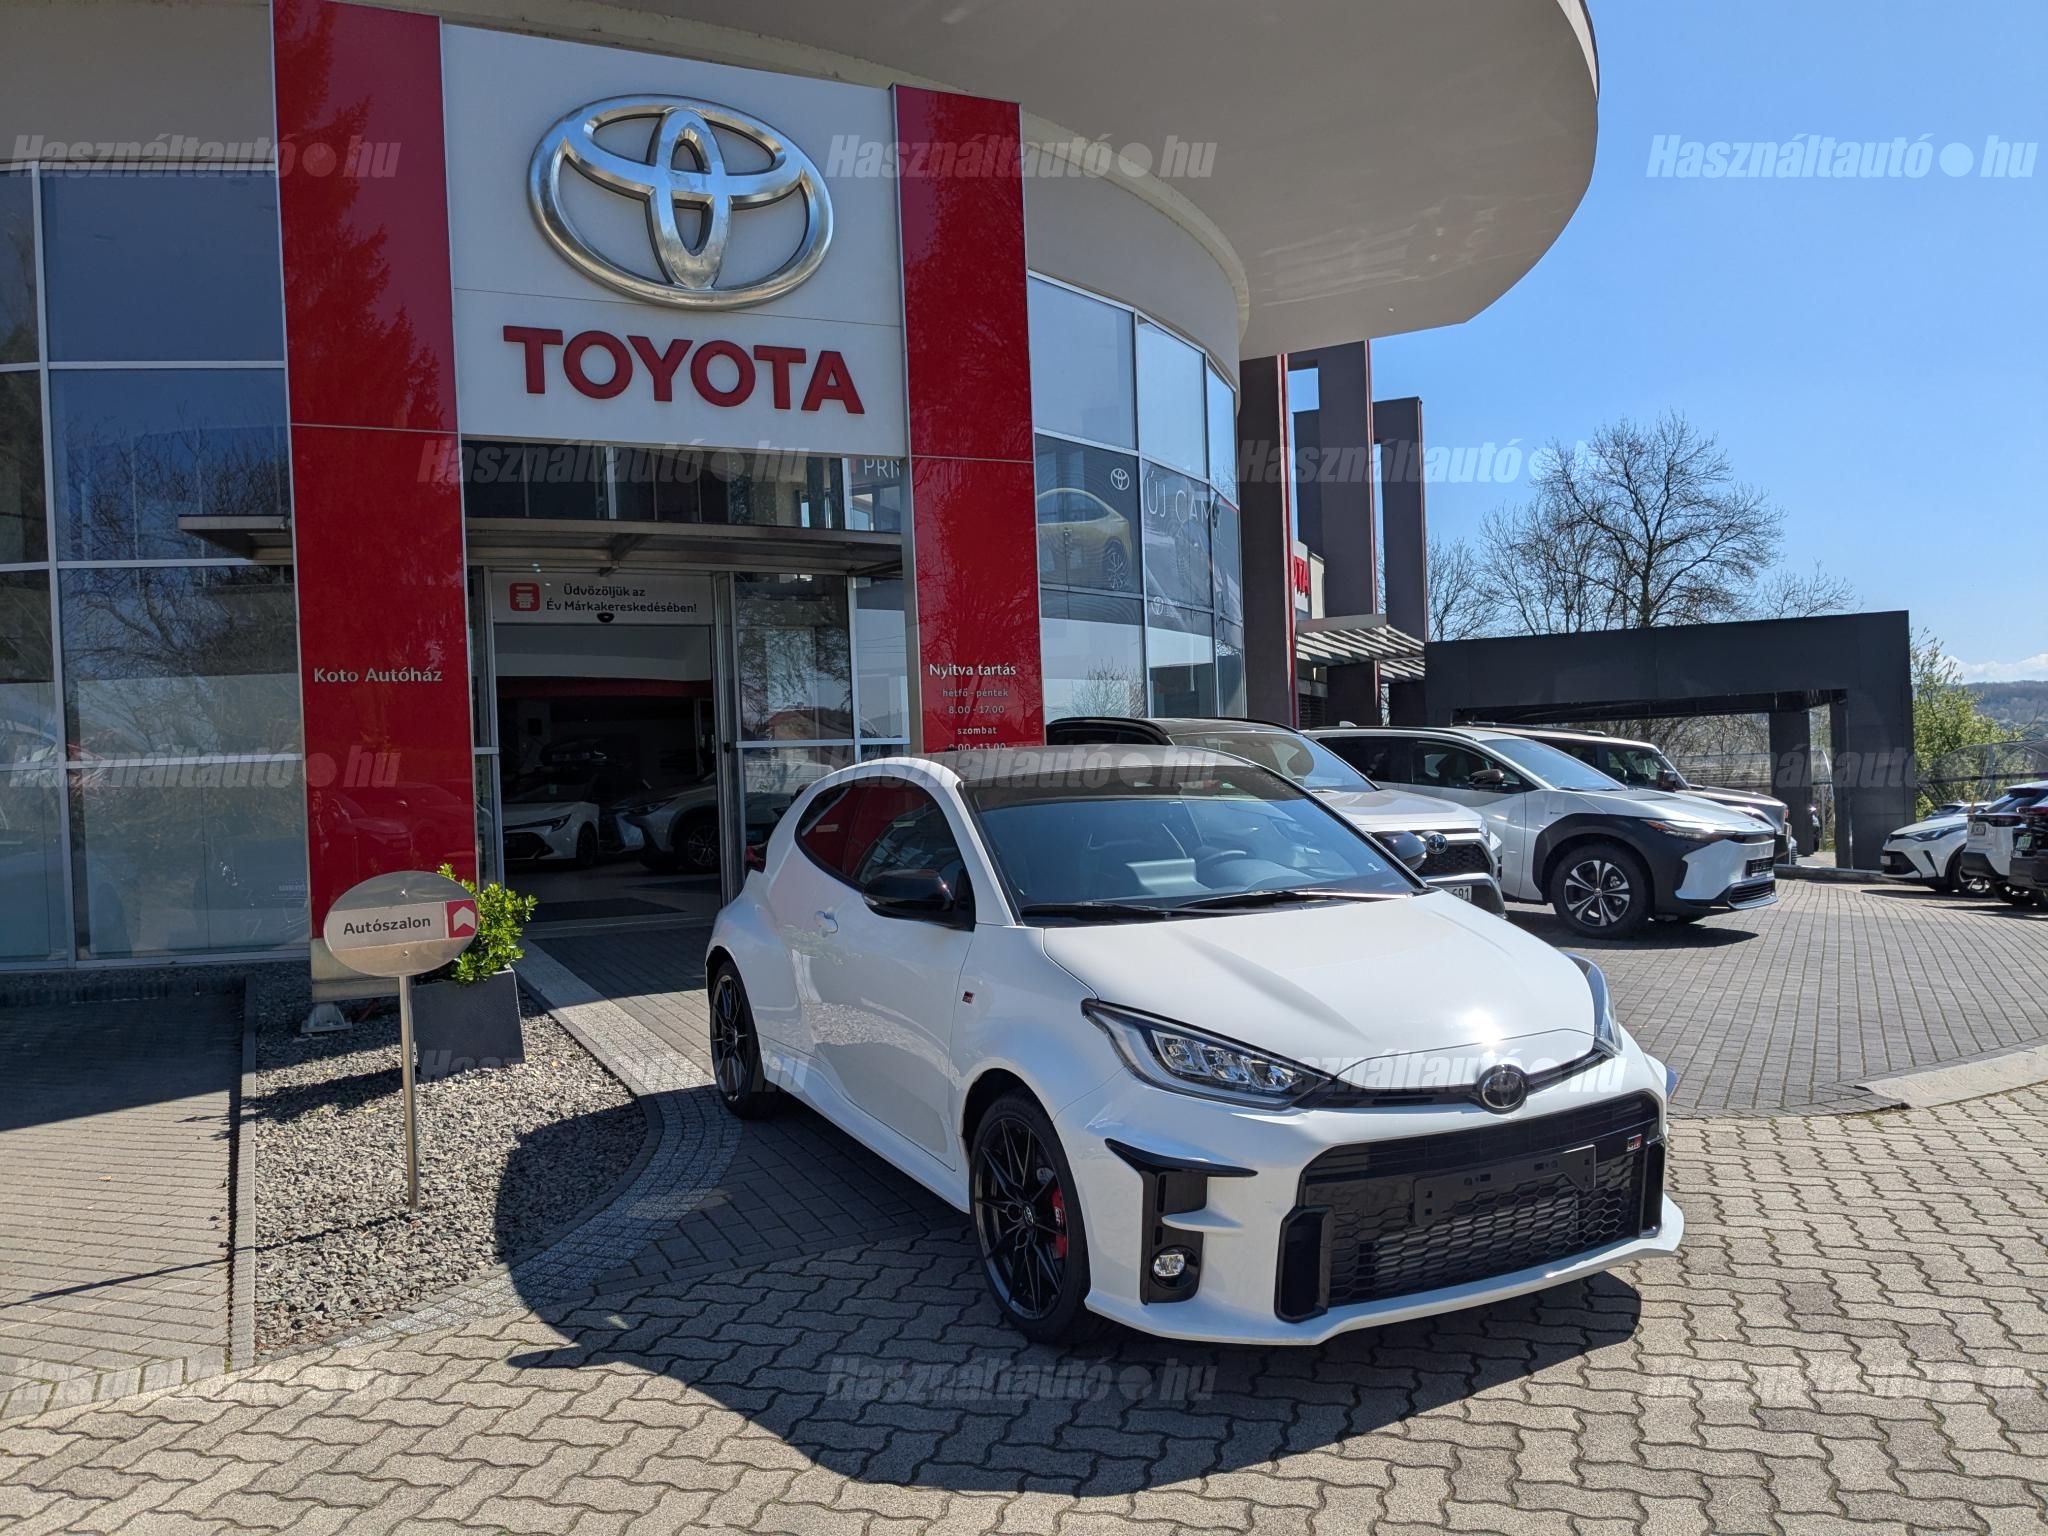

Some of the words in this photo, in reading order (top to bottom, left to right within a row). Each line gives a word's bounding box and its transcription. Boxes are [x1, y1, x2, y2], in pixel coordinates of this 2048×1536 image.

[503, 325, 865, 415] TOYOTA
[563, 583, 630, 599] Üdvözöljük
[632, 588, 646, 597] az
[546, 598, 562, 611] Év
[564, 600, 697, 613] Márkakereskedésében!
[314, 668, 359, 683] Koto
[365, 666, 443, 682] Autóház
[929, 664, 974, 680] Nyitva
[978, 662, 1017, 676] tartás
[976, 688, 1009, 698] péntek
[957, 726, 998, 735] szombat
[343, 917, 431, 935] Autószalon
